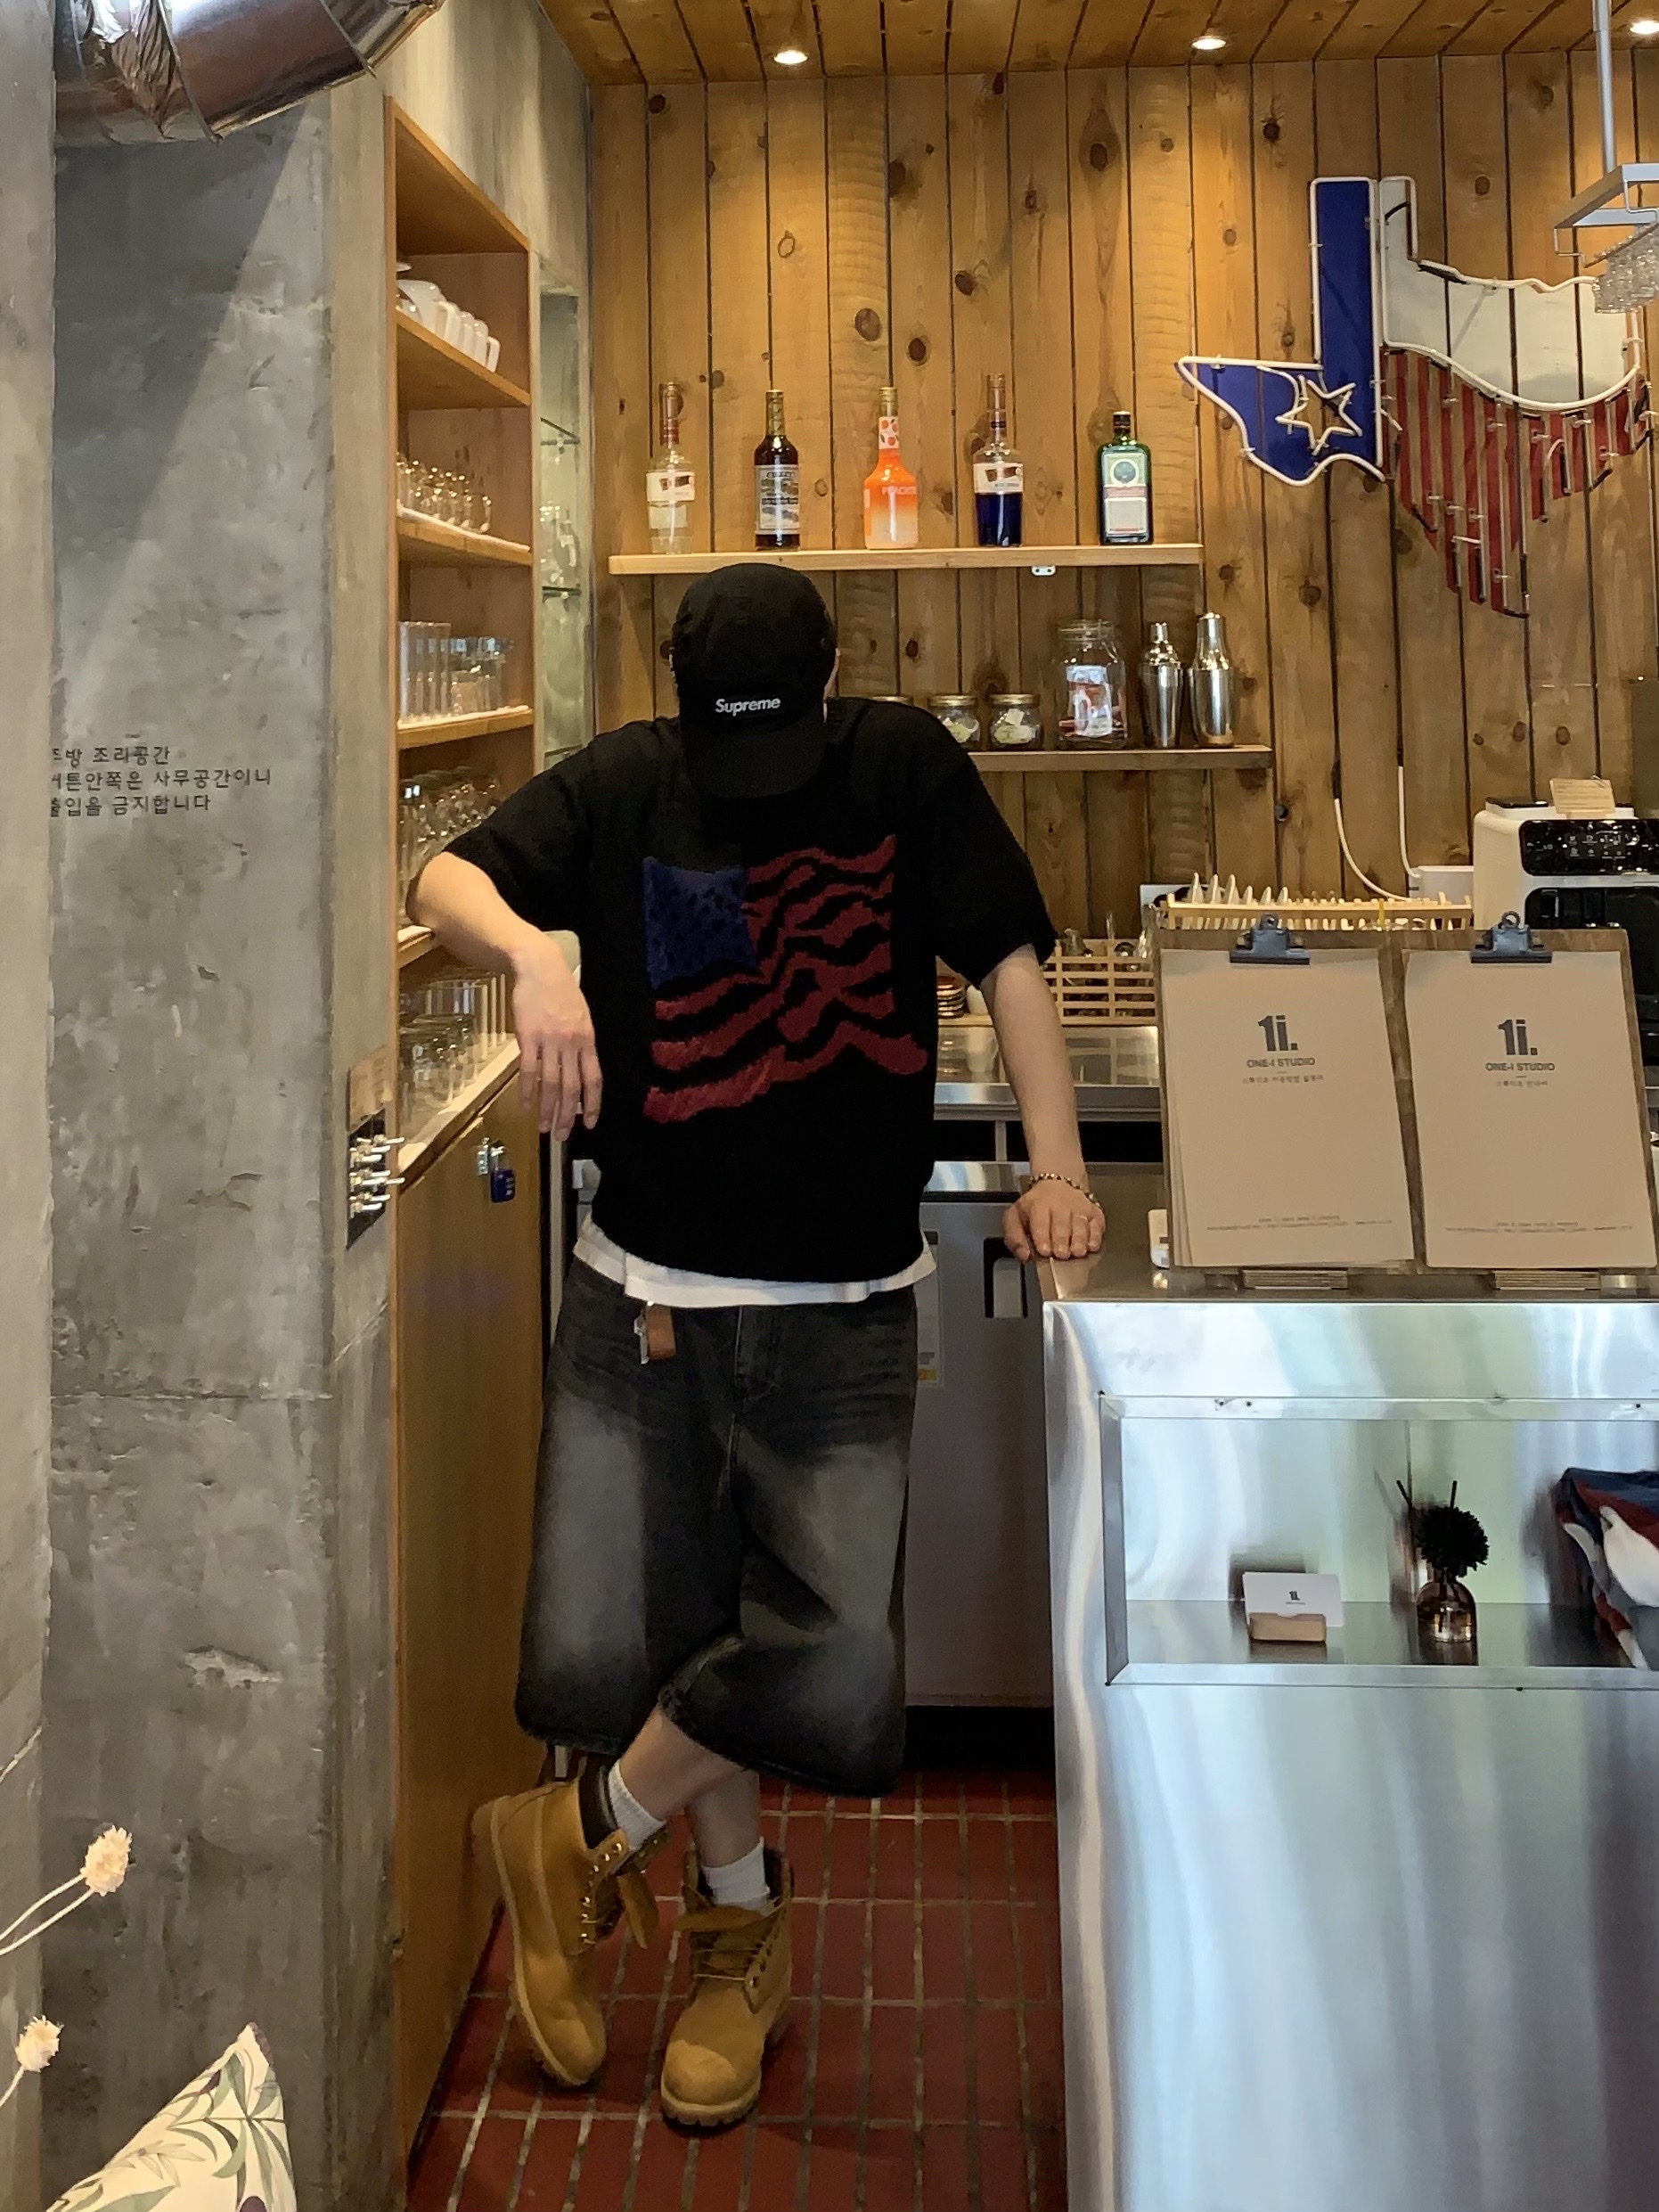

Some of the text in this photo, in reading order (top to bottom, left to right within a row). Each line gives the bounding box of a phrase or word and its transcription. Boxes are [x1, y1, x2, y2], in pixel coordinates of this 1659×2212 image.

[715, 698, 781, 717] Supreme
[92, 746, 170, 766] 조리공간
[153, 768, 271, 789] 사무공간이니
[111, 794, 212, 815] 금지합니다
[1277, 1057, 1316, 1067] STUDIO
[1516, 1061, 1556, 1071] STUDIO
